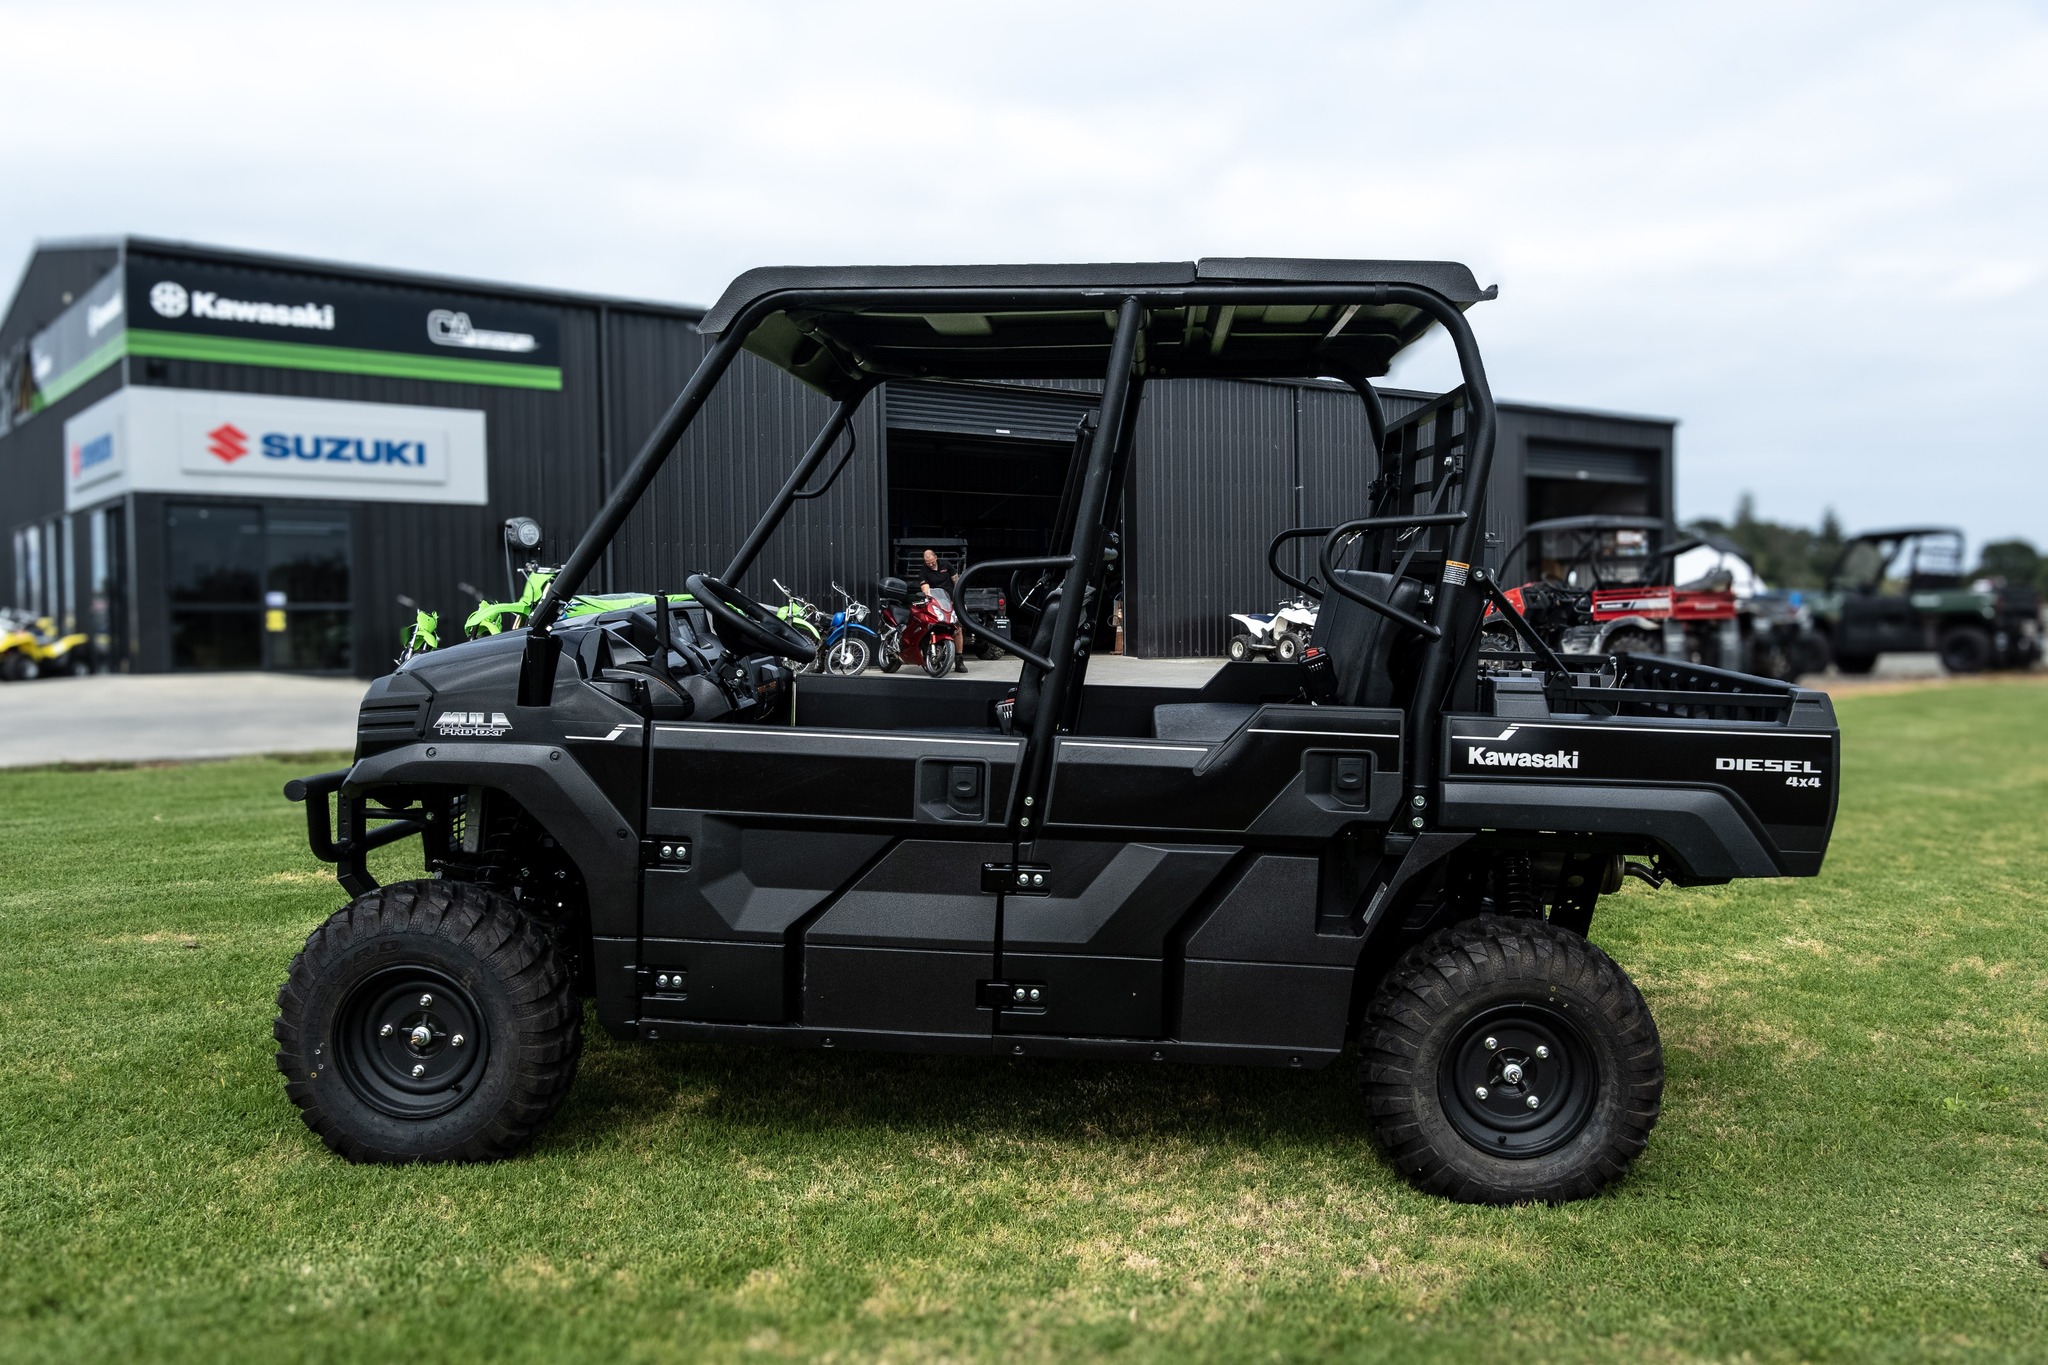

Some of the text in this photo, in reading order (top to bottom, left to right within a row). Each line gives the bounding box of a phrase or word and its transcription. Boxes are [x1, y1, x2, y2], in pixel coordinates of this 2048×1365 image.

[191, 290, 335, 330] Kawasaki
[261, 431, 427, 466] SUZUKI
[433, 711, 513, 730] MULE
[1468, 746, 1579, 769] Kawasaki
[1716, 758, 1822, 773] DIESEL
[1785, 776, 1822, 788] 4x4
